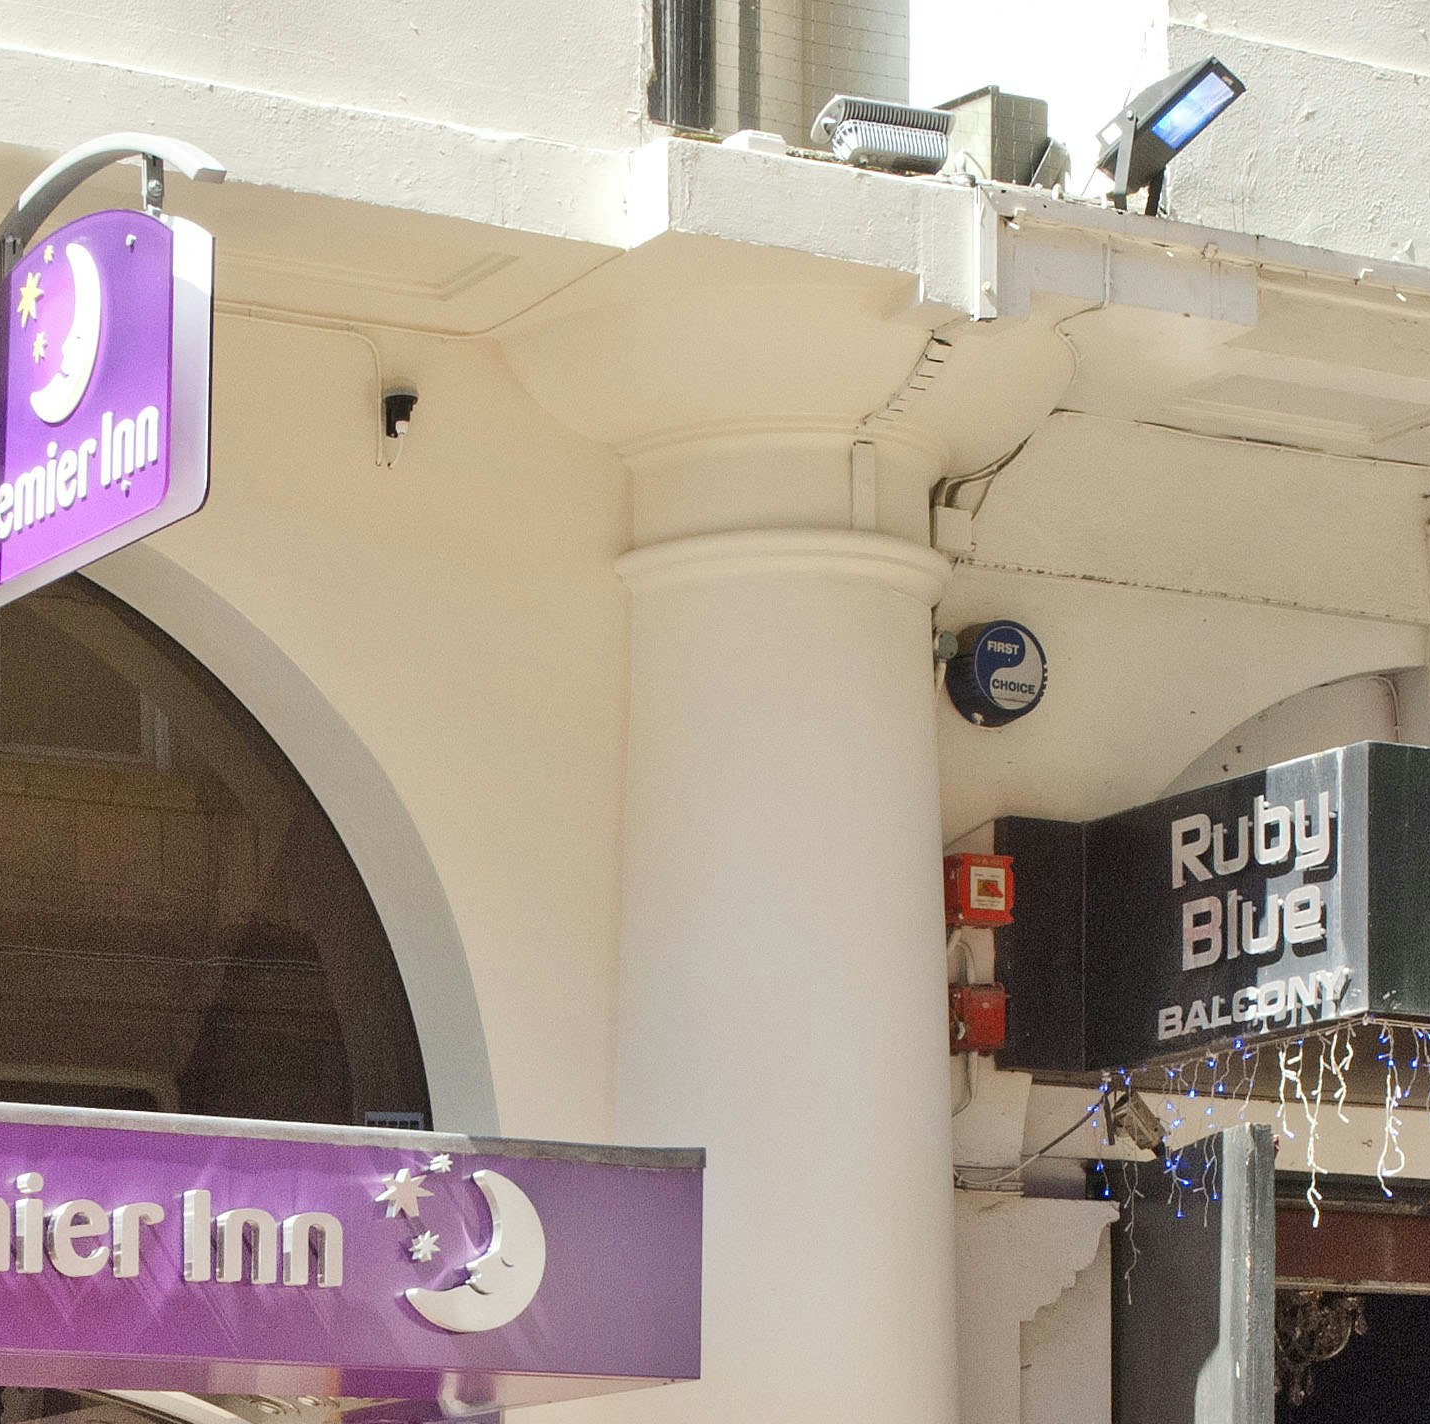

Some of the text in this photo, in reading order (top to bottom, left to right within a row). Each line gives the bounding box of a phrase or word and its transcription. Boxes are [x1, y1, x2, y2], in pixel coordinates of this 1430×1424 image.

[101, 405, 161, 487] Inn
[987, 641, 1019, 655] FIRST
[992, 679, 1035, 694] CHOICE
[1172, 791, 1331, 889] Ruby
[1182, 885, 1323, 971] Blue
[1158, 966, 1349, 1041] BALCONY
[183, 1188, 344, 1288] Inn
